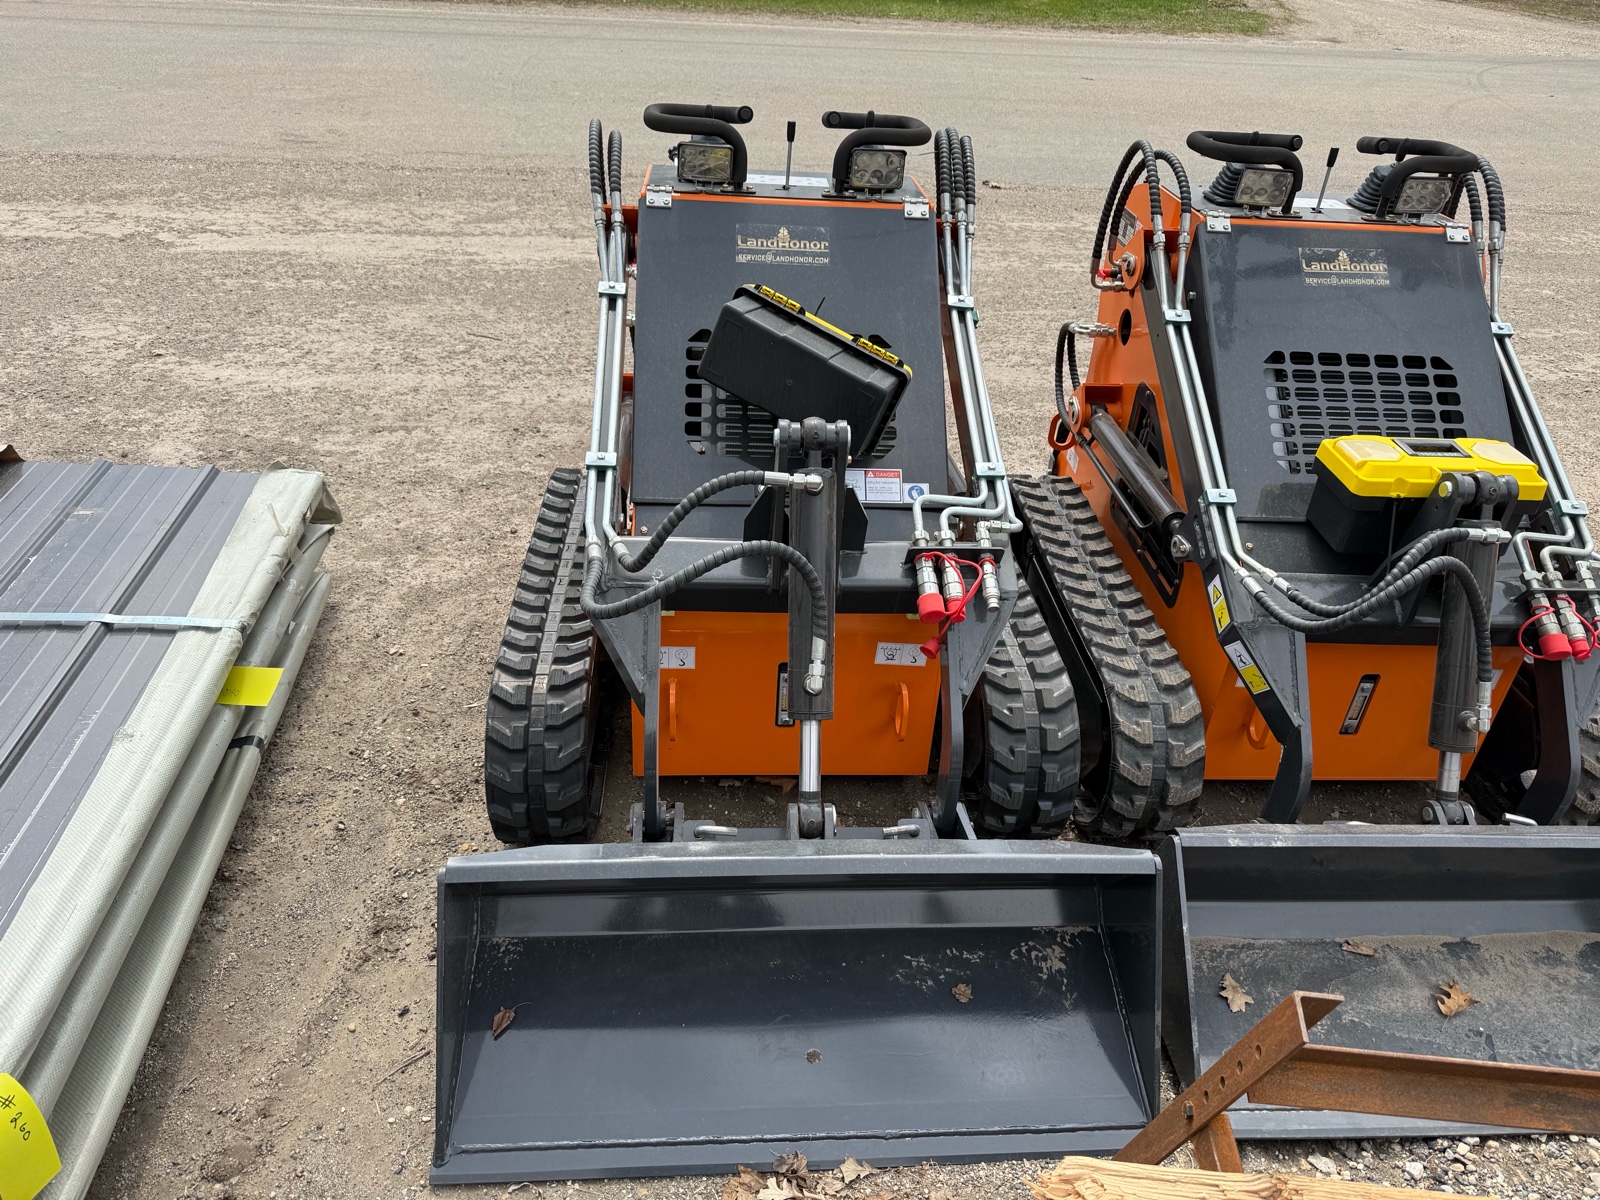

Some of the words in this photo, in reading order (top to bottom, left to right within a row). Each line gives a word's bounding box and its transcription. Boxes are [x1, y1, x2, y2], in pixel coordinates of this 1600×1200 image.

[737, 234, 829, 250] LandHonor
[738, 252, 829, 264] SERVICE@LANDHONOR.COM
[1302, 259, 1388, 272] LandHonor
[1305, 275, 1390, 286] SERVICE@LANDHONOR.COM
